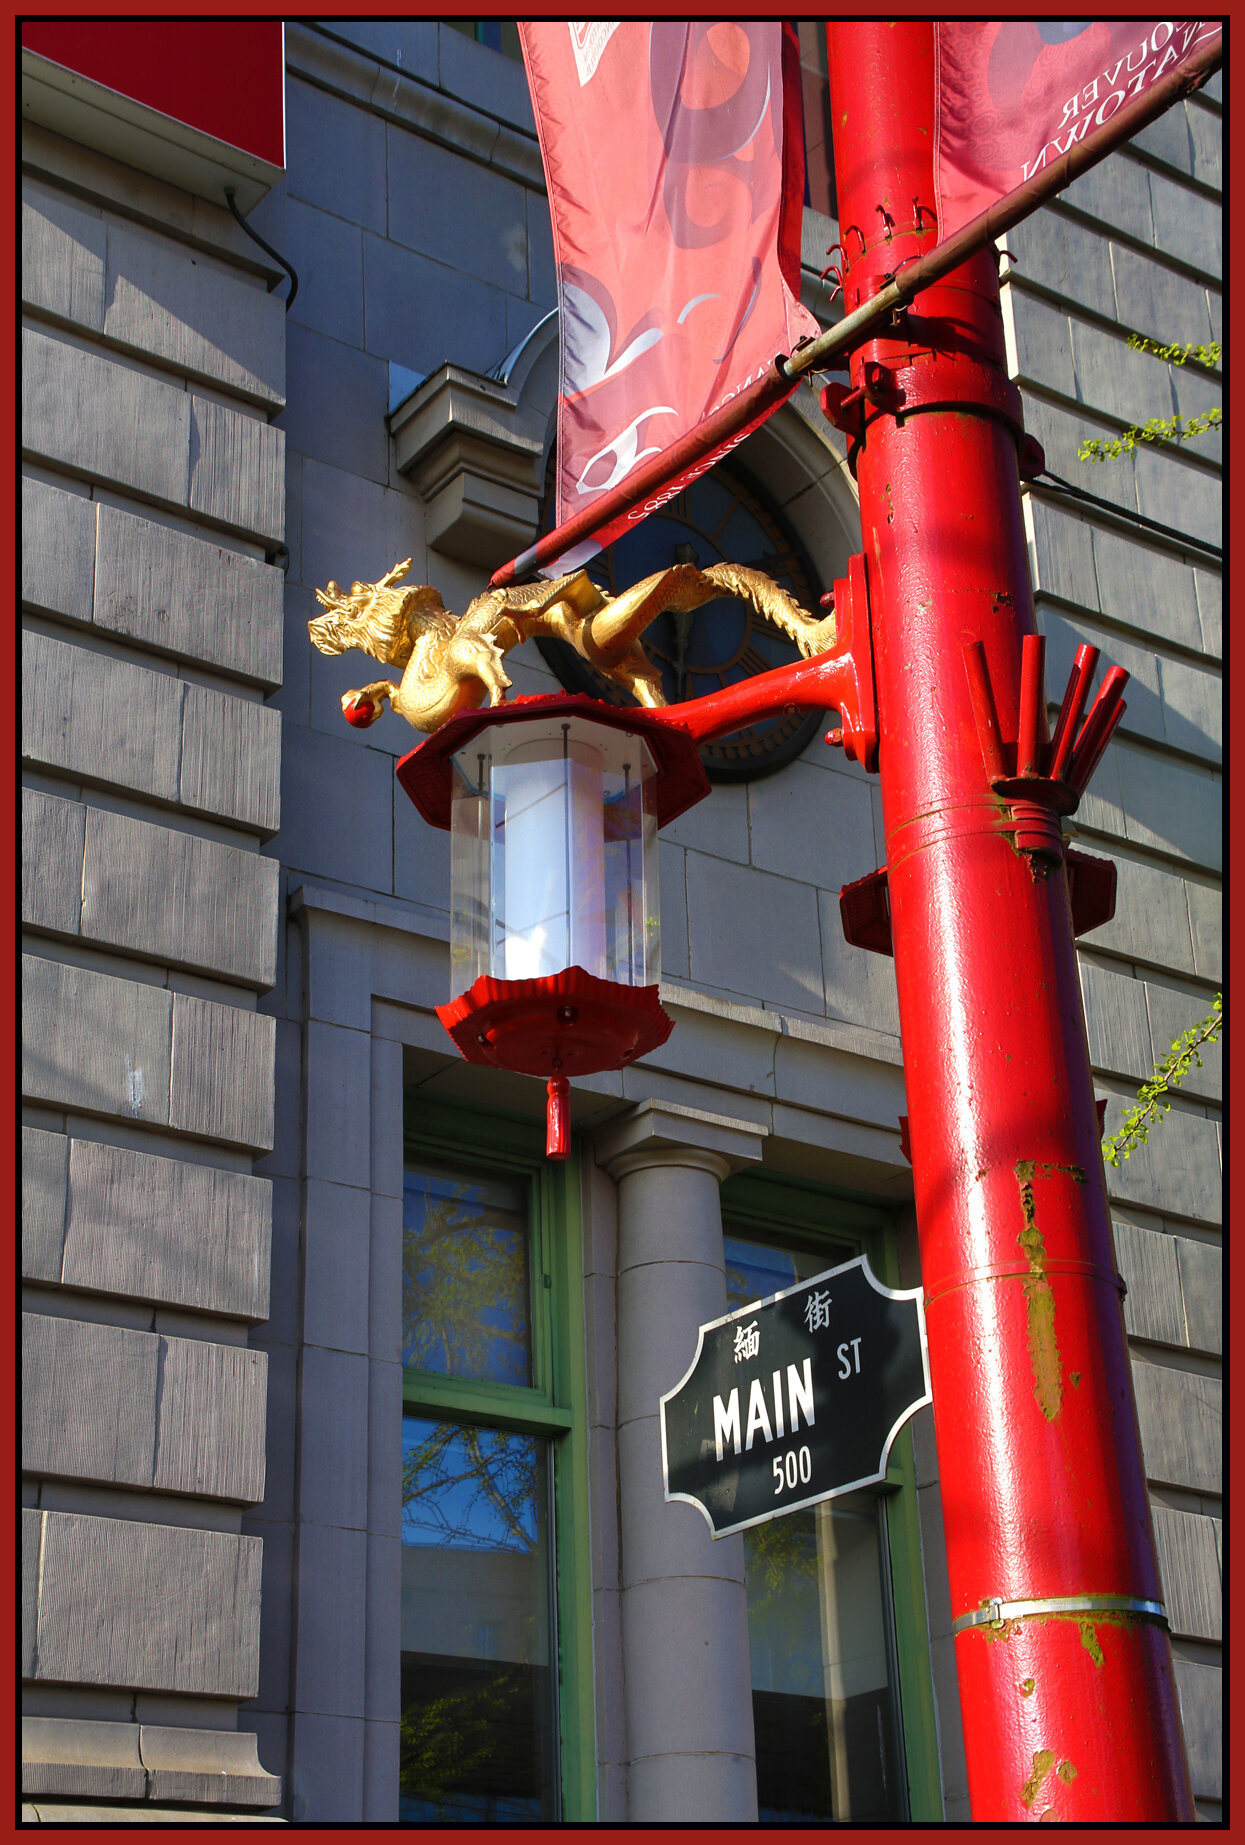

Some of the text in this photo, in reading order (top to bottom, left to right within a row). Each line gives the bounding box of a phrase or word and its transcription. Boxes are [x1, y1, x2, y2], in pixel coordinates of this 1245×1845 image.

[804, 1290, 833, 1334] 街
[712, 1337, 862, 1462] MAIN ST
[772, 1446, 812, 1495] 500
